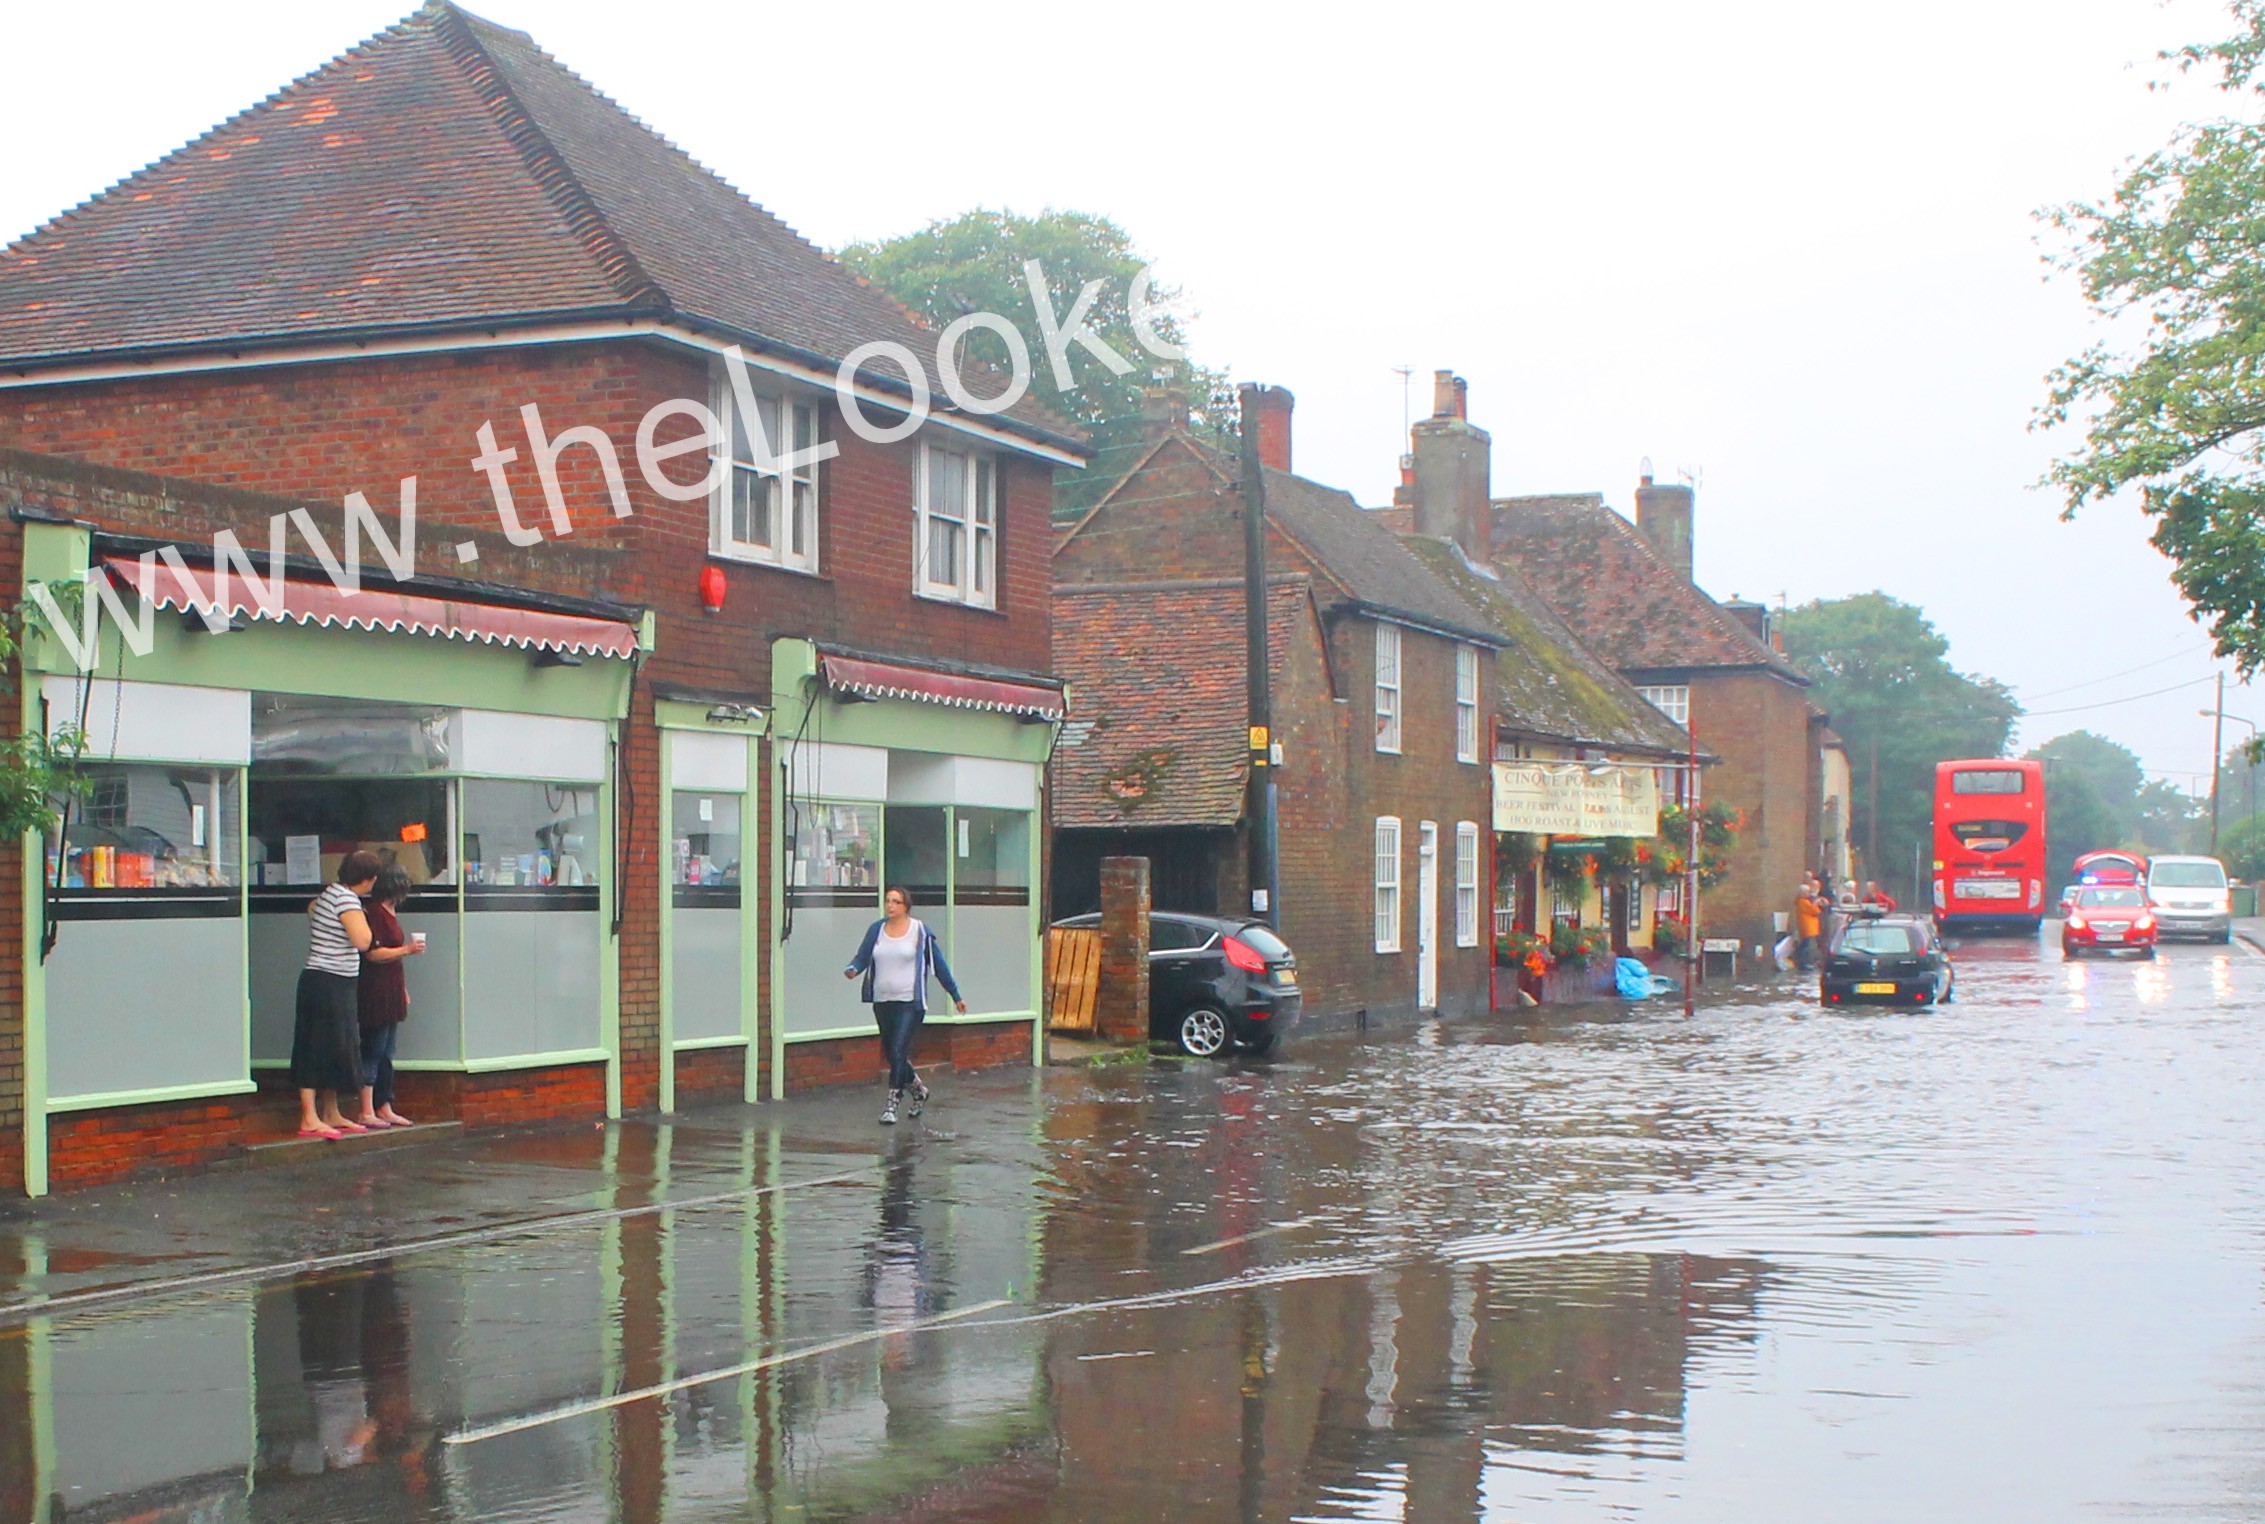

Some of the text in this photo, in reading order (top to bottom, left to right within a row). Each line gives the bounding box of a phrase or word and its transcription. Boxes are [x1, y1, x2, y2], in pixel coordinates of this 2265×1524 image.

[1504, 770, 1561, 787] CINQUE
[1496, 800, 1524, 810] BEER
[1527, 801, 1576, 813] FESTIVAL
[1535, 817, 1571, 827] ROAST
